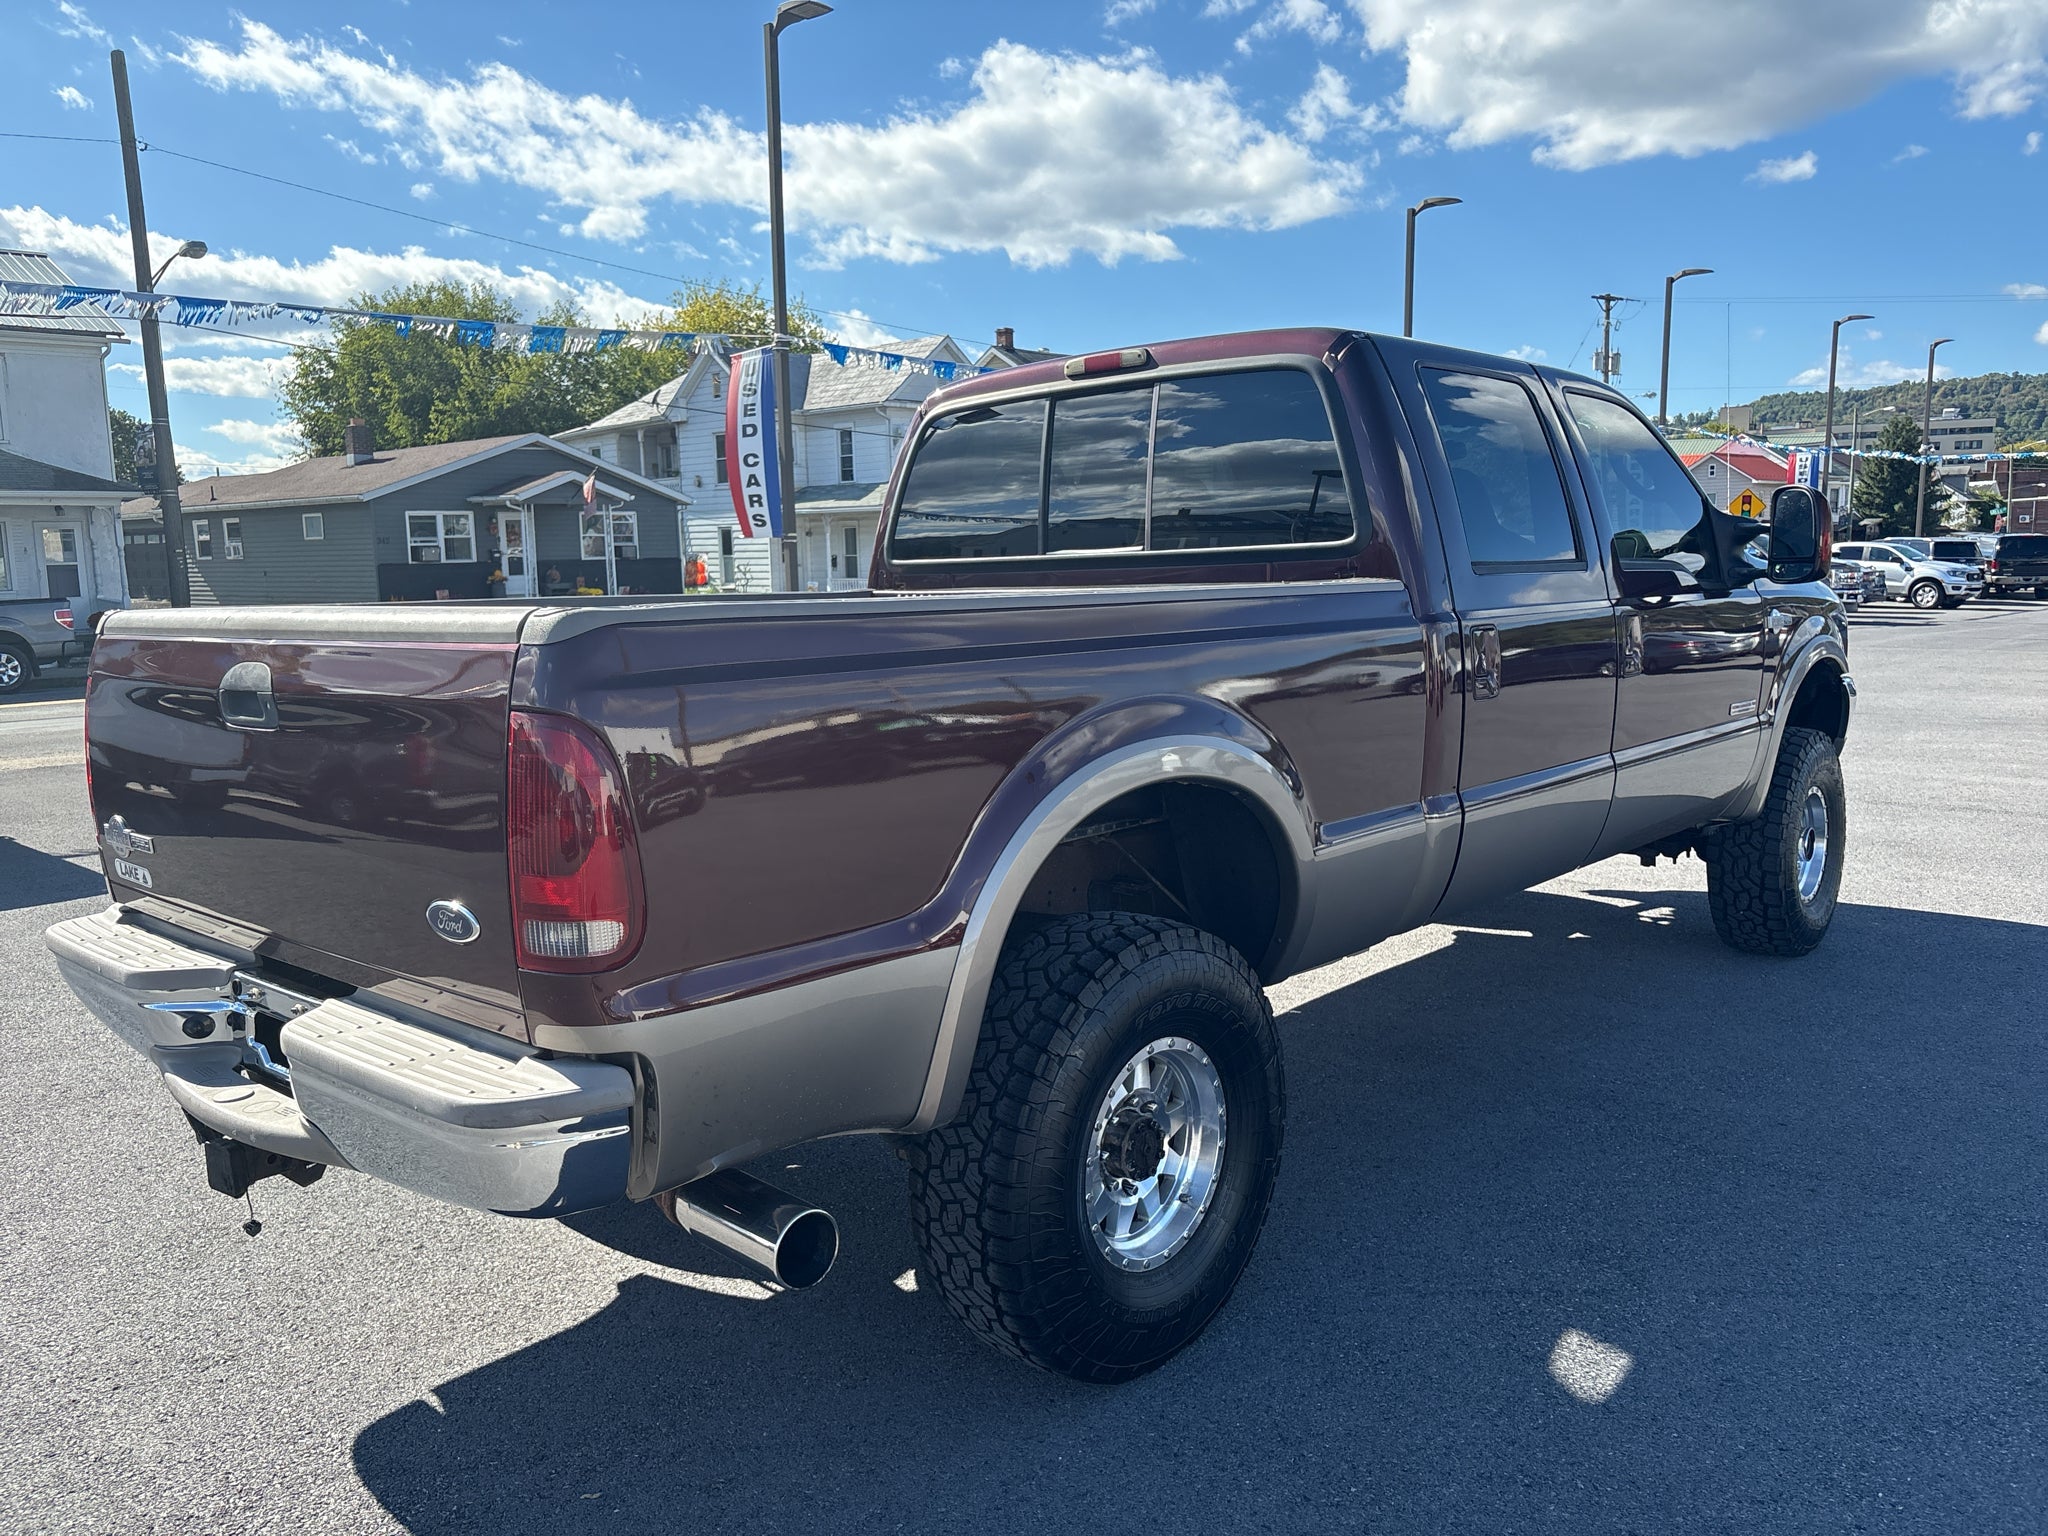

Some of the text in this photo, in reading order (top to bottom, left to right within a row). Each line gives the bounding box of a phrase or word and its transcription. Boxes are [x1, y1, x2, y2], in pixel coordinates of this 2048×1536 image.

[742, 361, 767, 528] USED CARS
[120, 862, 139, 881] LAKE
[437, 909, 463, 934] Ford
[1135, 992, 1192, 1033] TOYO
